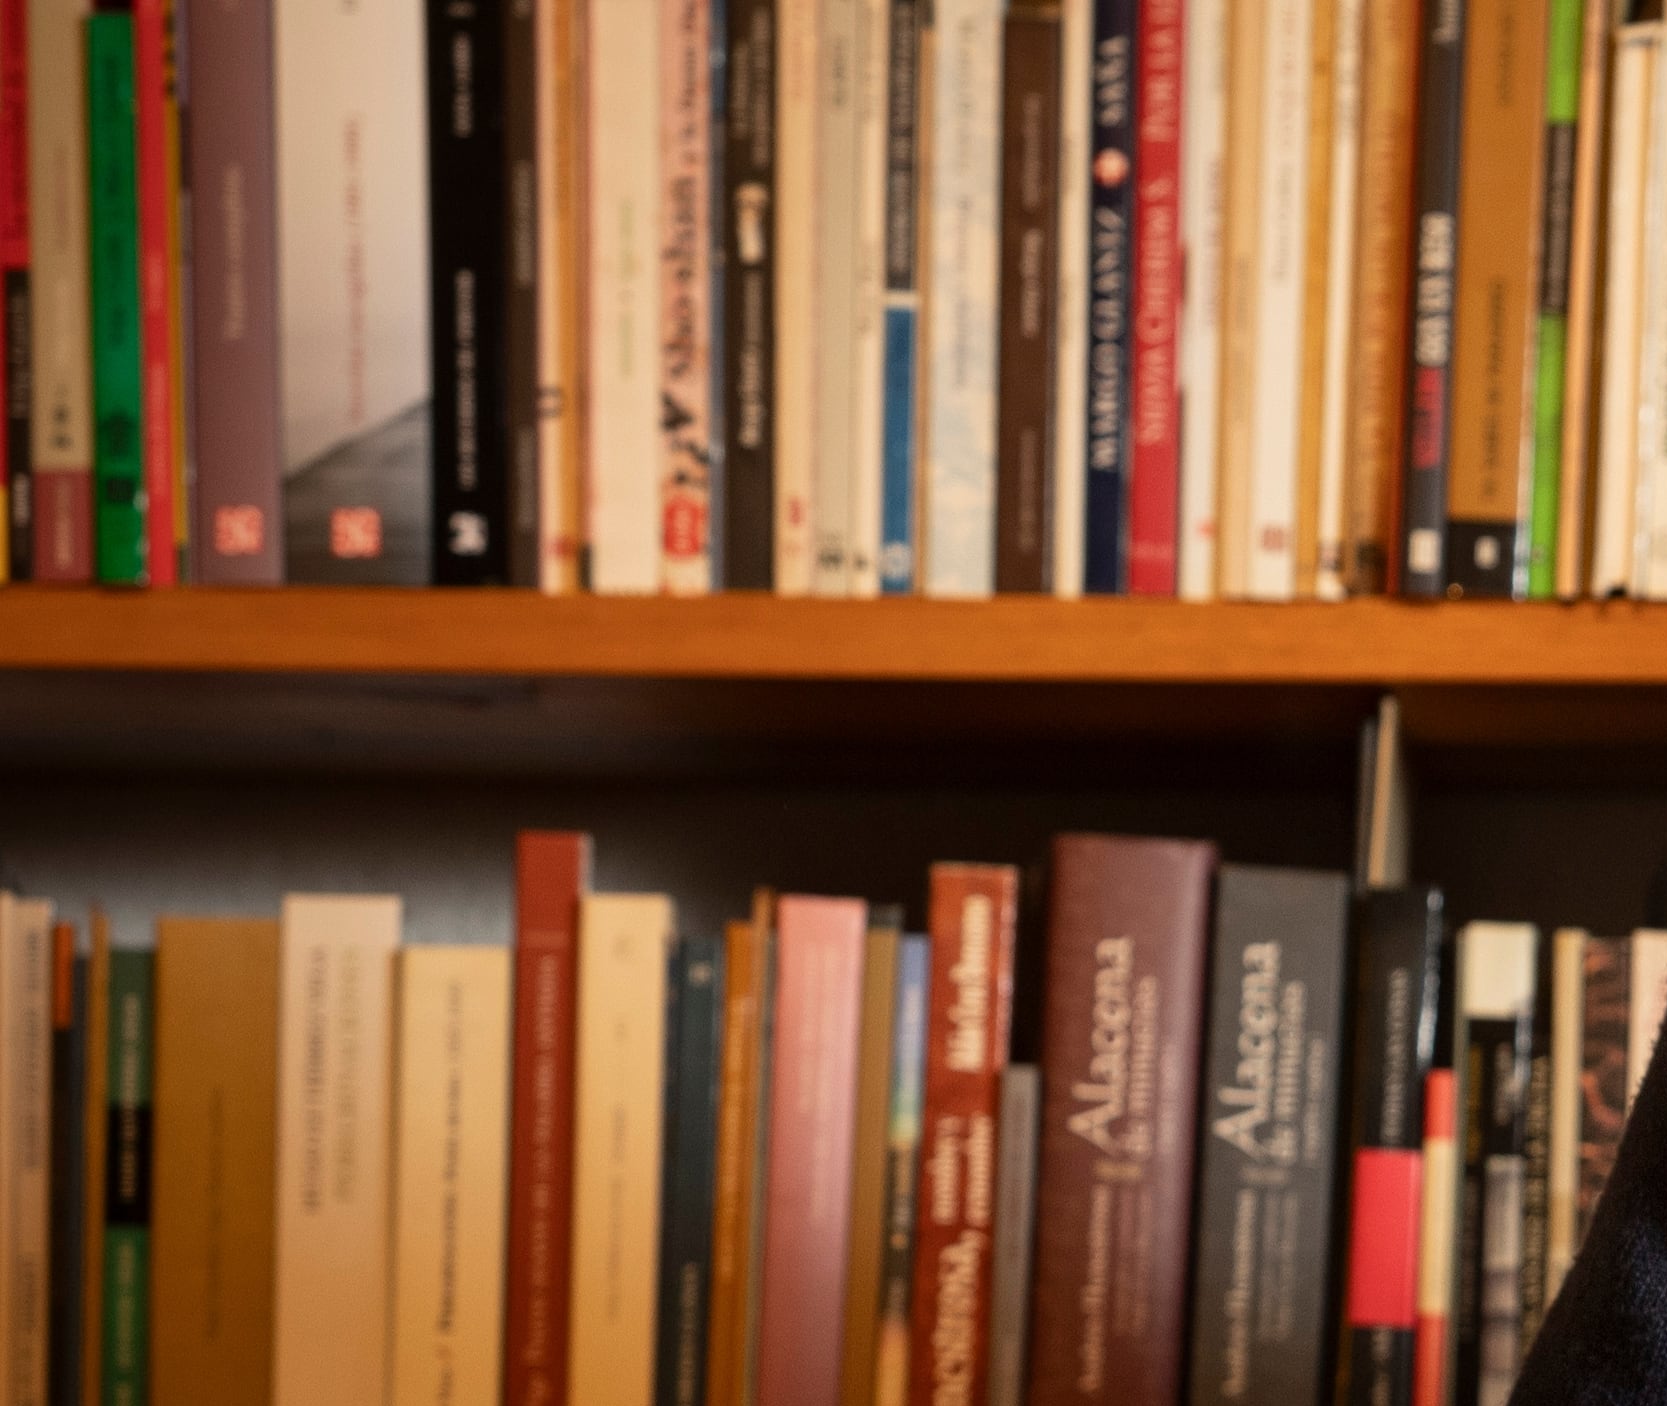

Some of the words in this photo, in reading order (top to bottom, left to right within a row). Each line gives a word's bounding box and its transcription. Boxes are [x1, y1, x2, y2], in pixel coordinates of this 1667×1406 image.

[1094, 208, 1122, 341] GLANTZ
[1092, 343, 1119, 471] MARGO
[1067, 935, 1134, 1156] Alacena
[1212, 942, 1281, 1162] Alacena
